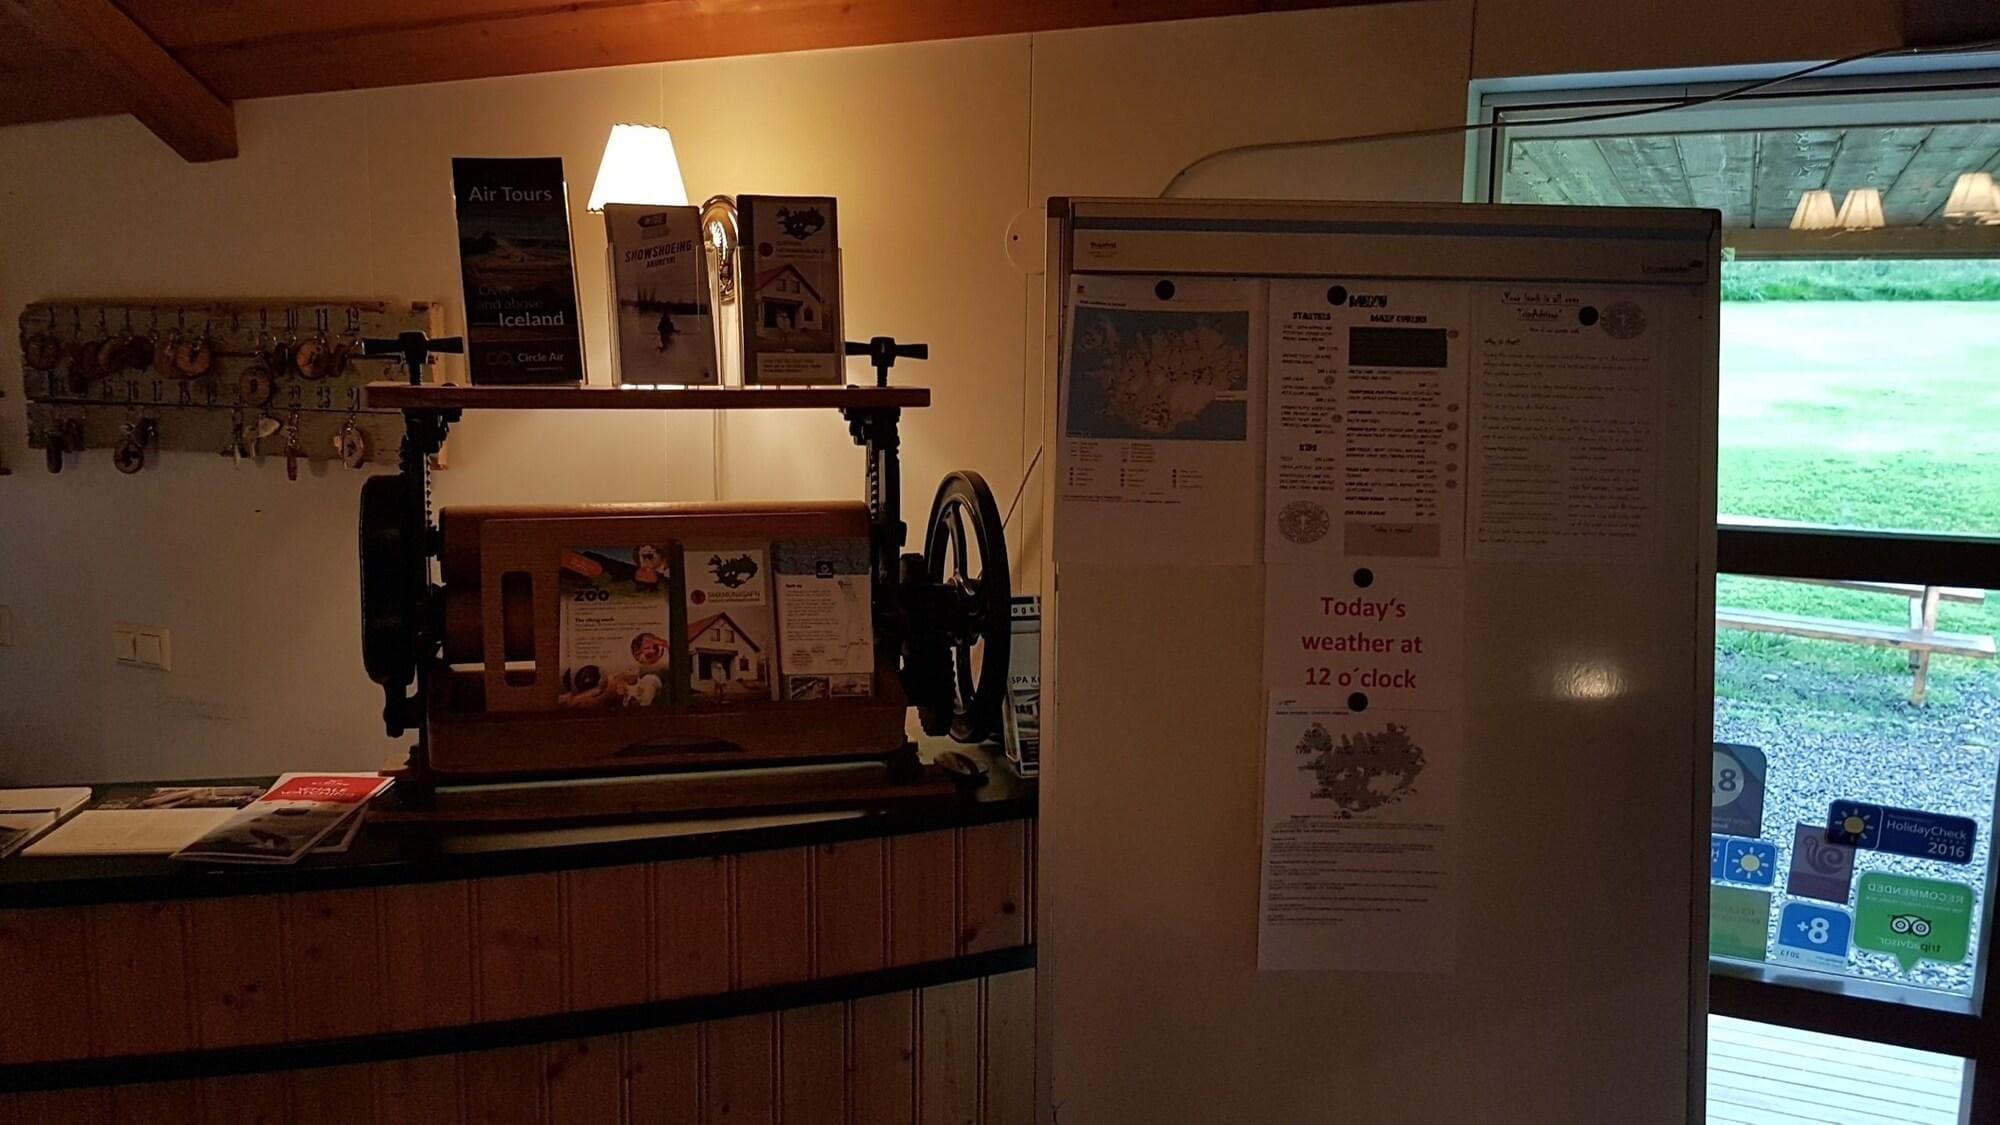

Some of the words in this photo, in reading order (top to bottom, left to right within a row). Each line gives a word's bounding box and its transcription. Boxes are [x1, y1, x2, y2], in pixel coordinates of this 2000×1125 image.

[468, 186, 497, 202] Air
[501, 186, 552, 202] Tours
[625, 240, 693, 263] SNOWSHOEING
[286, 307, 300, 331] 10
[315, 307, 329, 332] 11
[498, 310, 565, 327] Iceland
[575, 590, 610, 602] ZOO
[1302, 632, 1395, 653] weather
[1401, 636, 1423, 654] at
[1306, 667, 1331, 686] 12
[1886, 819, 1968, 841] HolidayCheck
[1927, 841, 1966, 859] 2016
